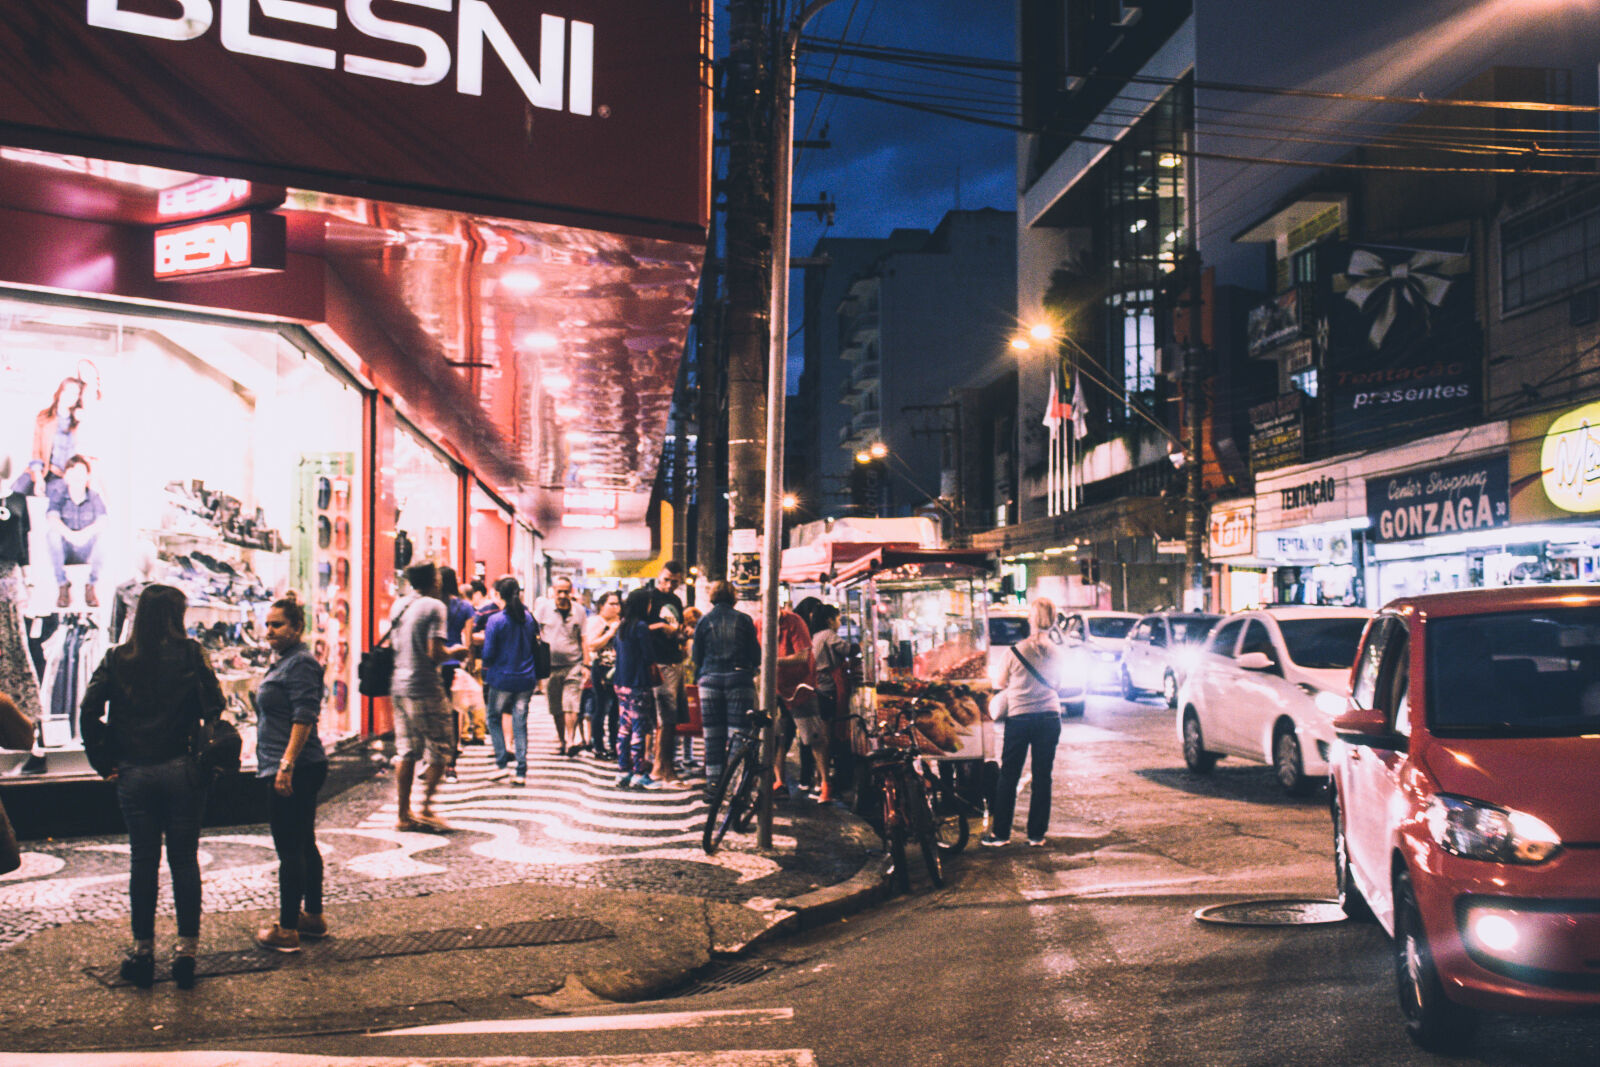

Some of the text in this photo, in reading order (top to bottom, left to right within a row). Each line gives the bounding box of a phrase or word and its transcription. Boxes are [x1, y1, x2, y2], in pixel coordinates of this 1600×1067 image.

[1281, 475, 1335, 510] TENTAÇÃO
[1426, 470, 1487, 500] Shopping
[1380, 494, 1494, 539] GONZAGA
